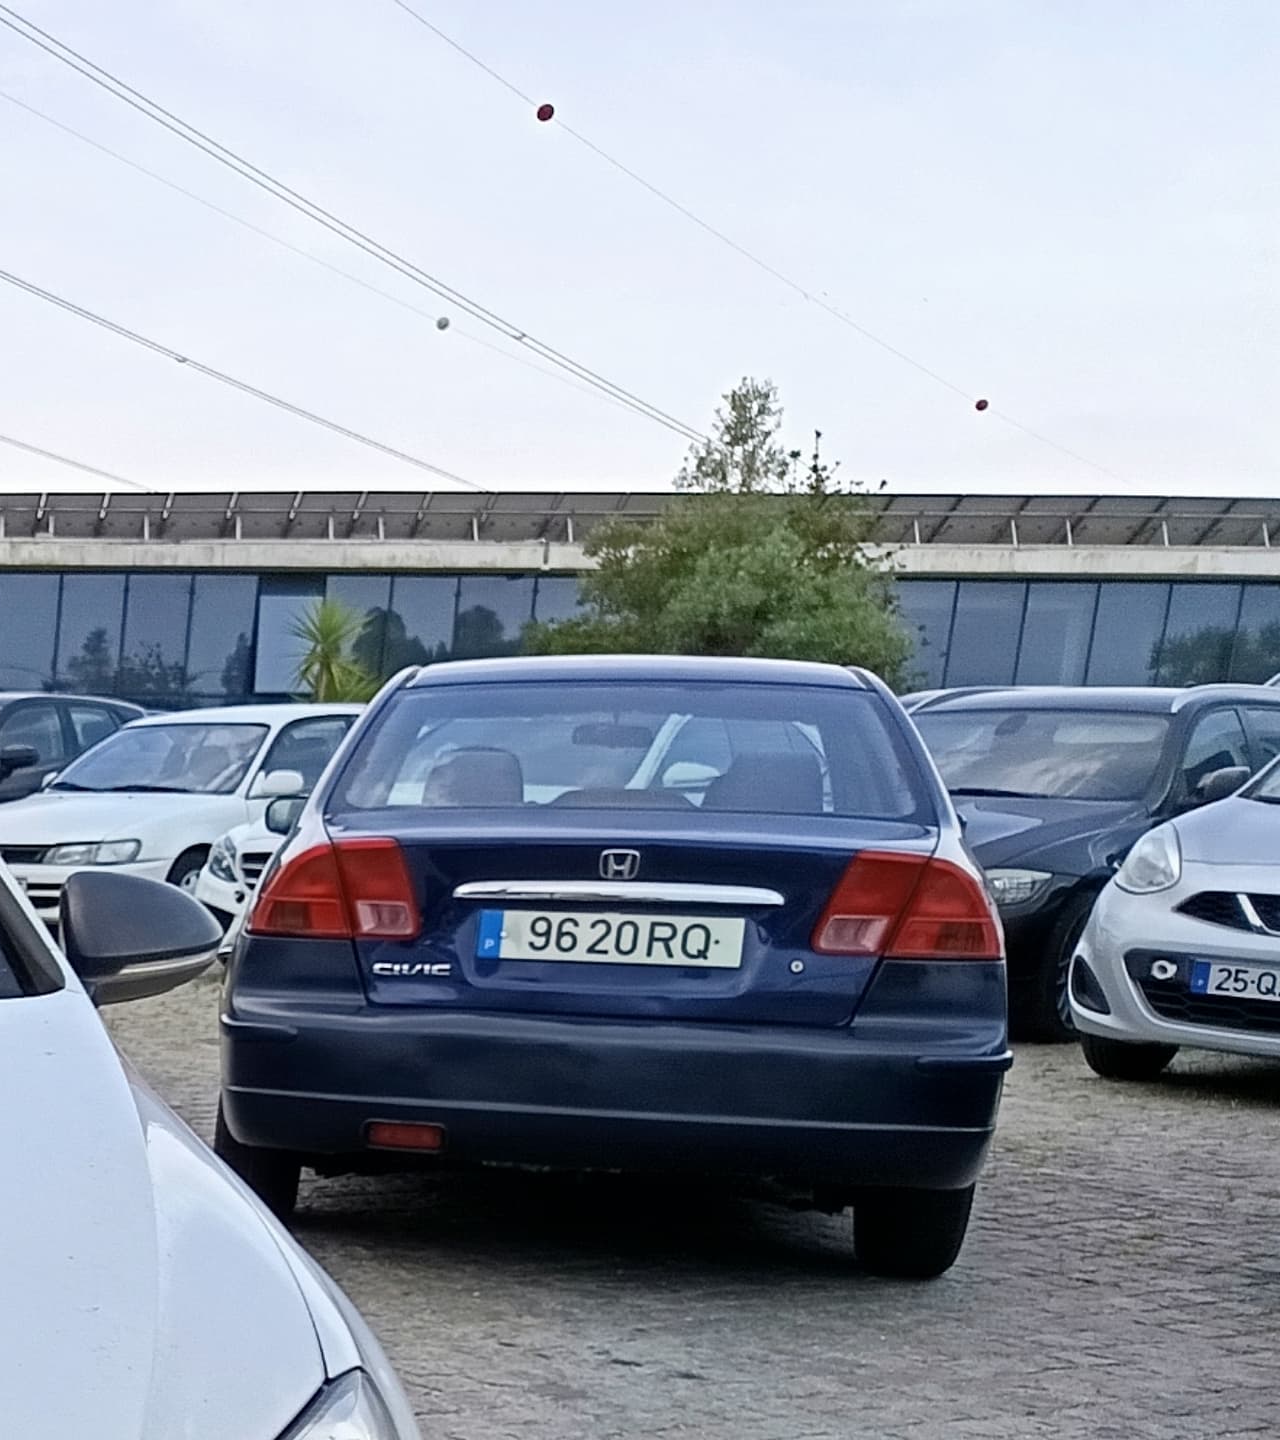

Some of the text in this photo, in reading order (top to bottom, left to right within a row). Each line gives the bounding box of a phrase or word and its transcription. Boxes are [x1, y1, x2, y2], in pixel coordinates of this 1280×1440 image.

[484, 938, 495, 950] P
[372, 962, 451, 976] CIVIC
[1215, 968, 1280, 997] 25-Q
